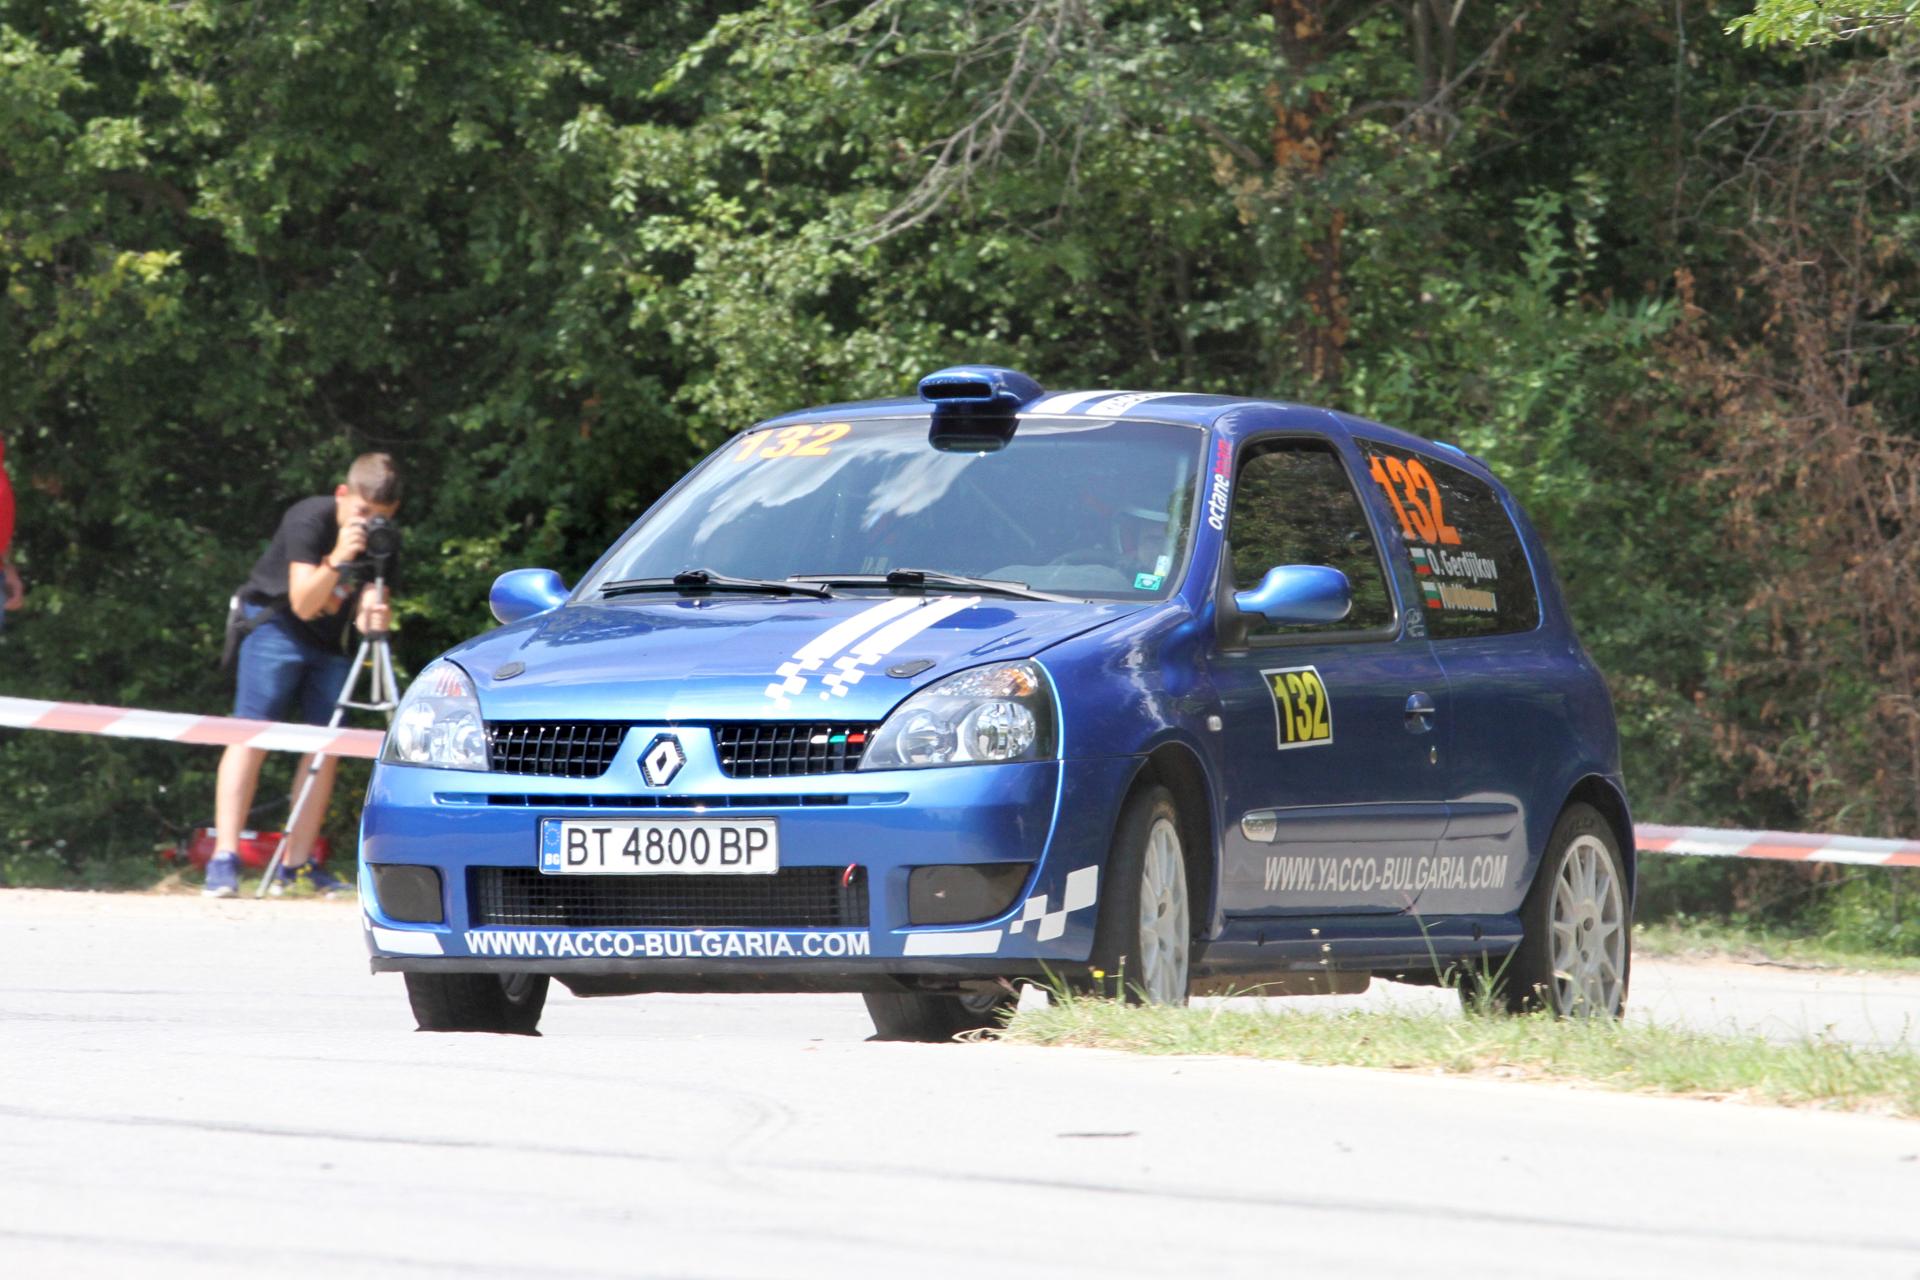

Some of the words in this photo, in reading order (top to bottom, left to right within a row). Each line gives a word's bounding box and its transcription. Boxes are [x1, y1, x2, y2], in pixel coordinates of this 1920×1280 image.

[733, 423, 852, 462] 132
[1370, 455, 1461, 544] 132
[1274, 671, 1329, 742] 132
[567, 828, 612, 865] BT
[622, 827, 710, 865] 4800
[720, 827, 768, 865] BP
[1264, 855, 1508, 891] WWW.YACCO-BULGARIA.COM
[464, 931, 871, 957] WWW.YACCO-BULGARIA.COM
